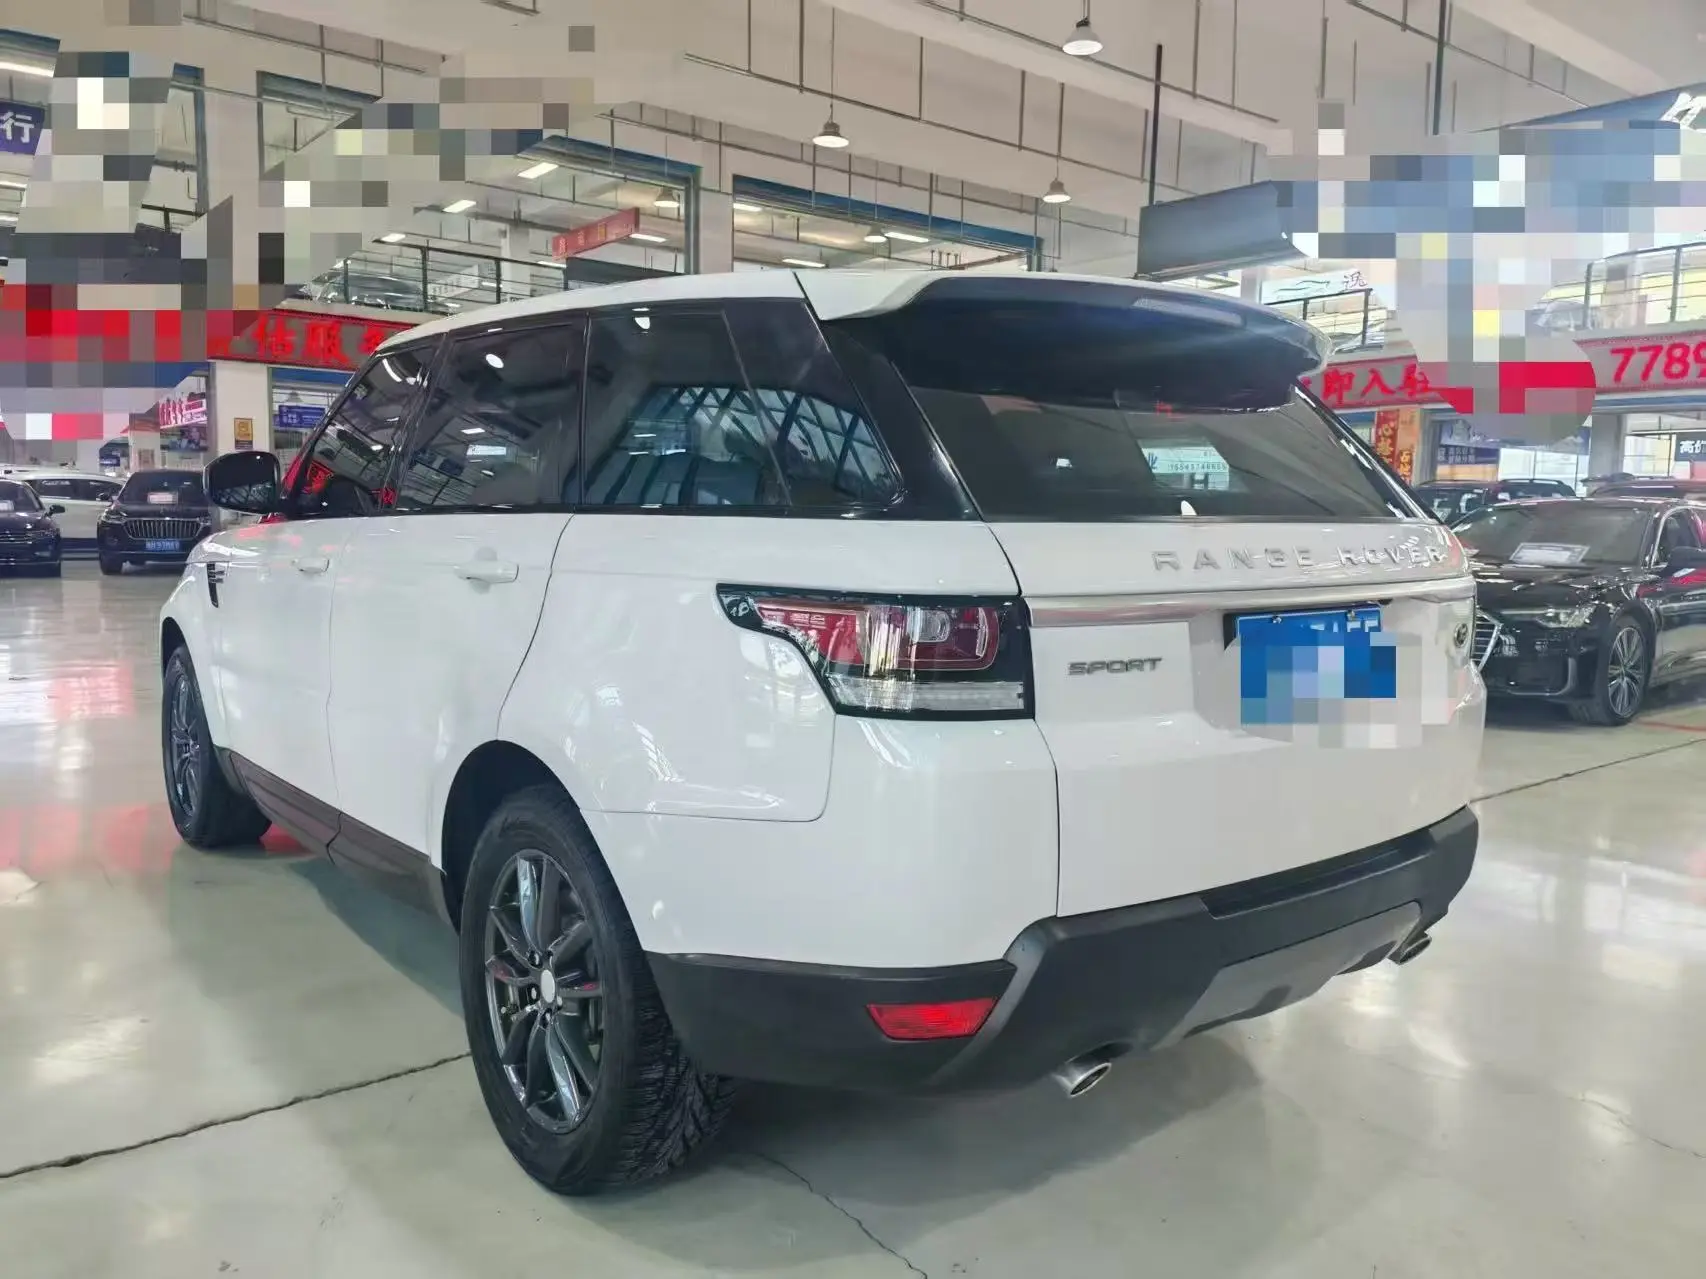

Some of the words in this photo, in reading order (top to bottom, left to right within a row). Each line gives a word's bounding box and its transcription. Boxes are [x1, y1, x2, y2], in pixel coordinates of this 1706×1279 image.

[1151, 547, 1316, 571] RANGE
[1336, 546, 1447, 569] ROVER
[1067, 656, 1163, 676] SPORT
